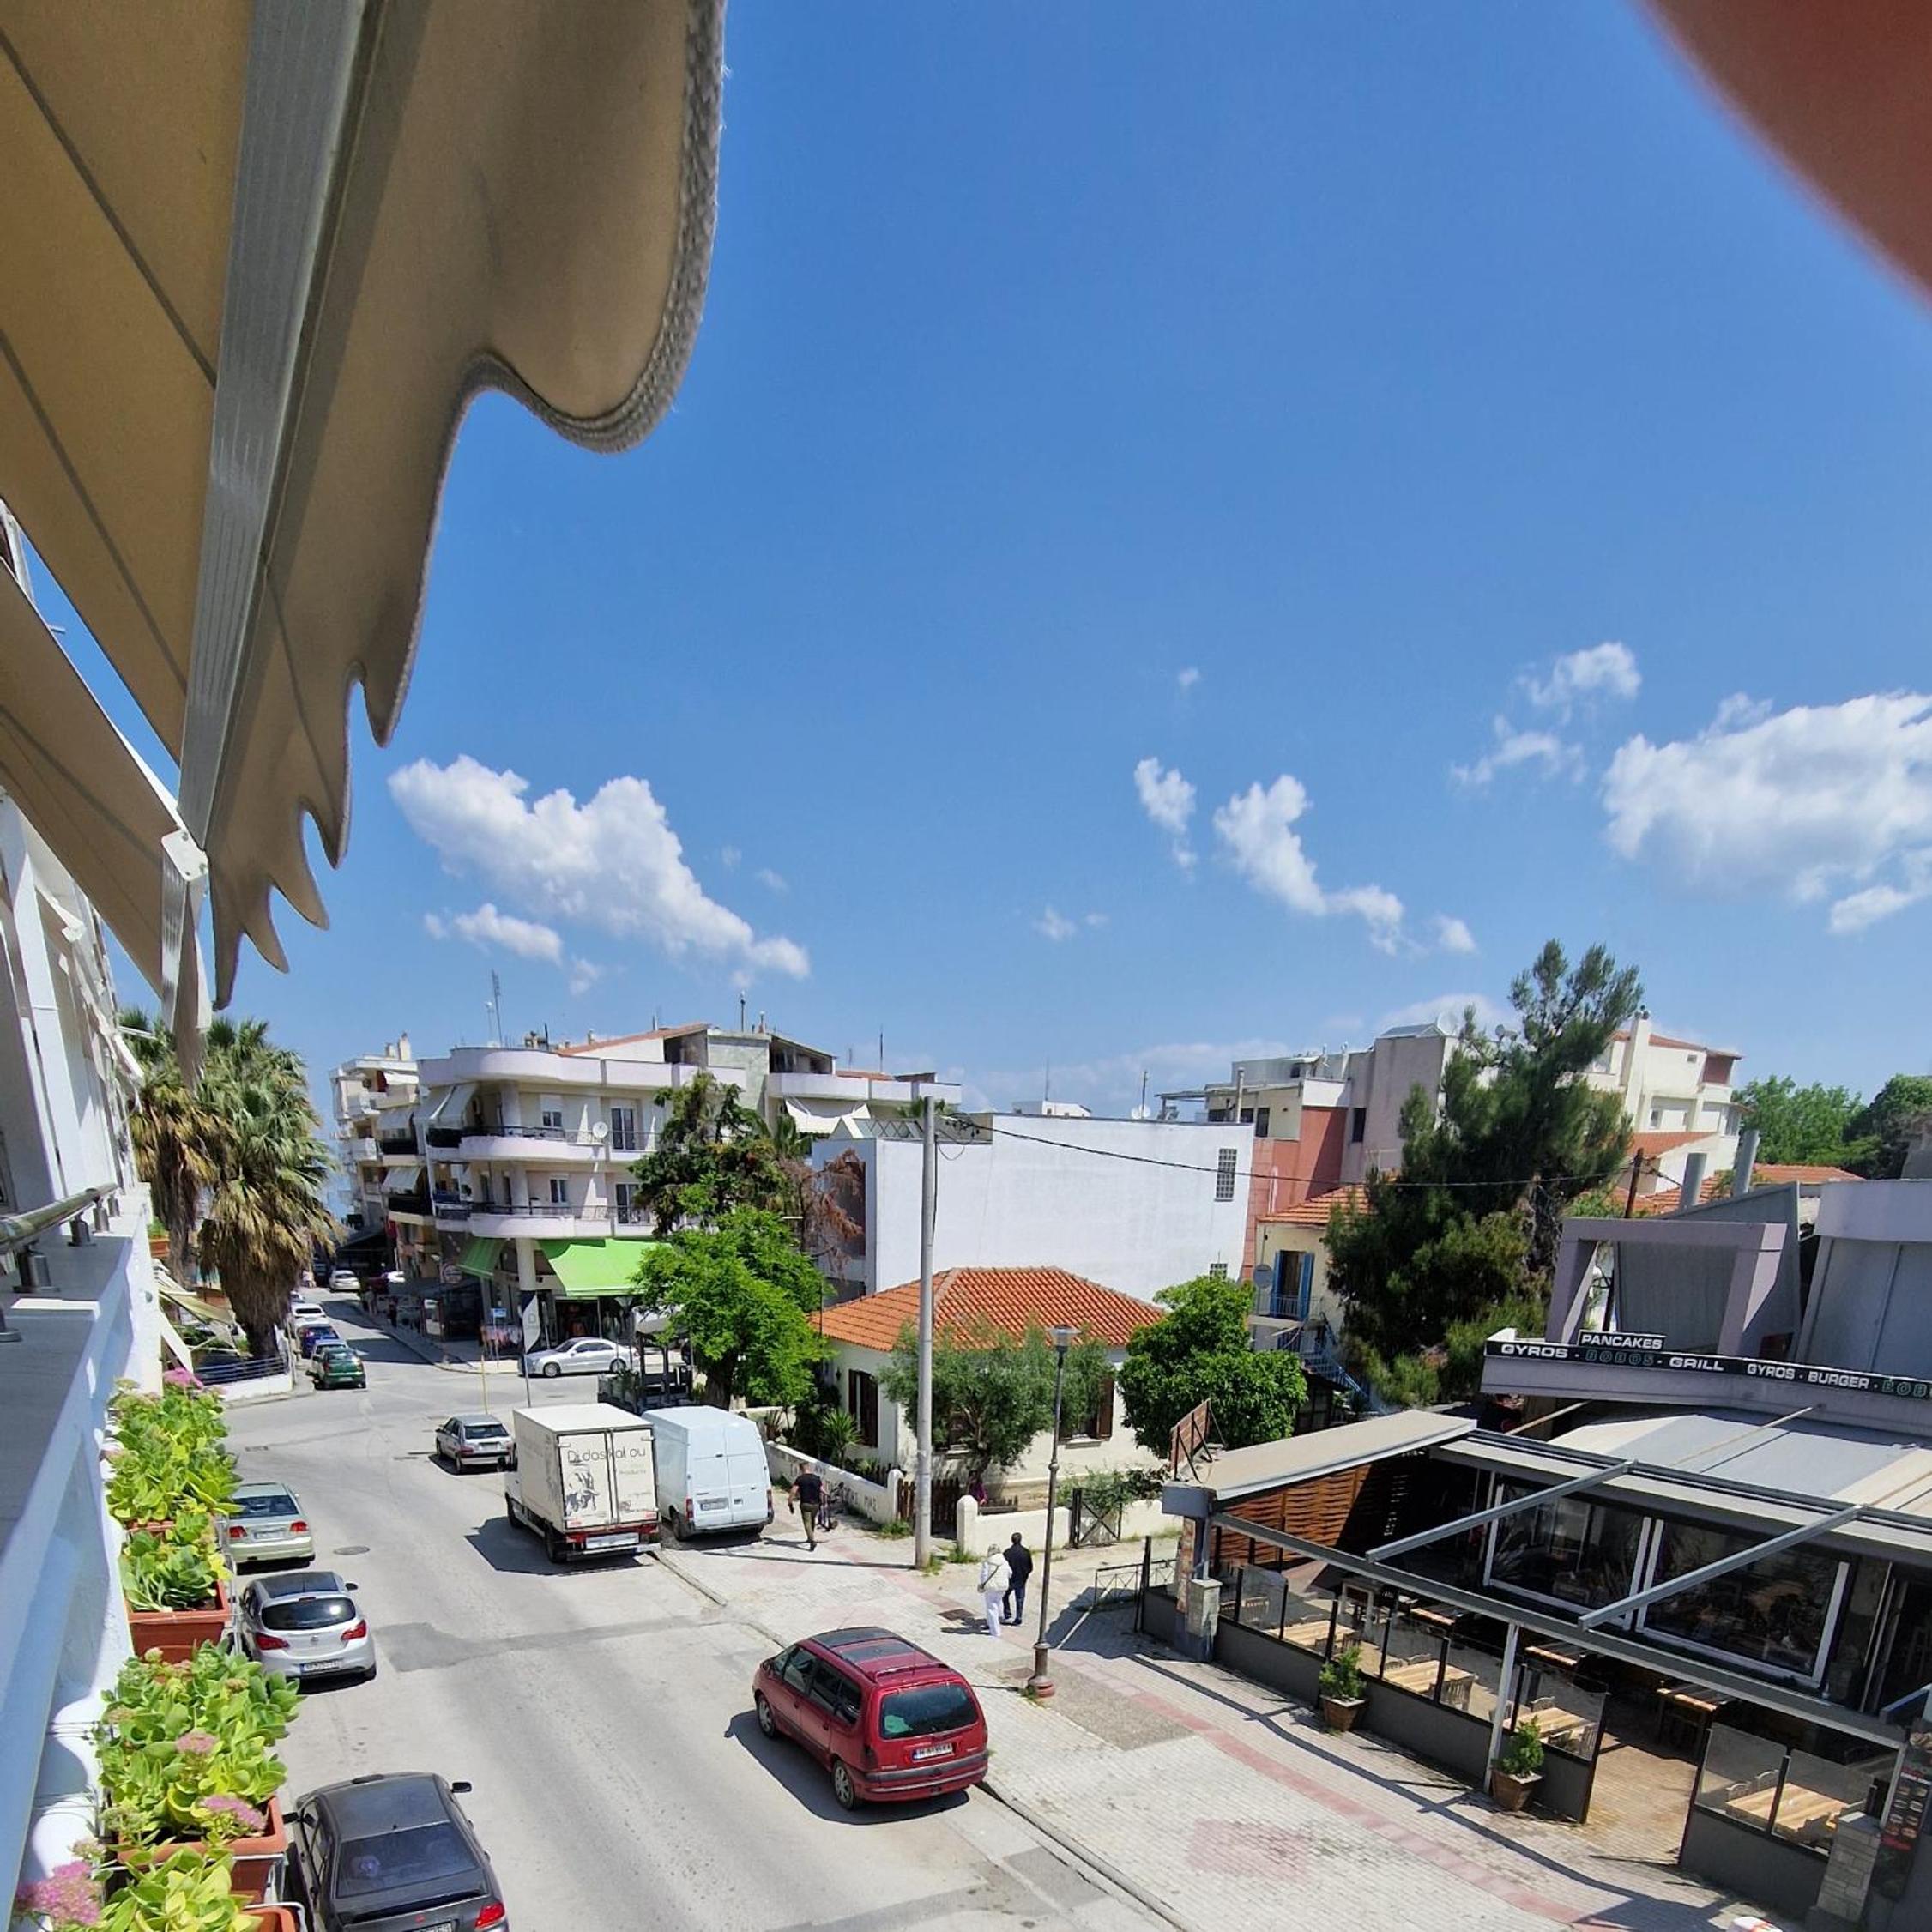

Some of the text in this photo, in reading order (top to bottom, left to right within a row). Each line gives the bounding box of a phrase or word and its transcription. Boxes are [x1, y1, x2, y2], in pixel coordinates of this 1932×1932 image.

[1581, 1334, 1663, 1350] PANCAKES
[1501, 1343, 1569, 1359] GYROS
[1669, 1356, 1724, 1372] GRILL
[1747, 1362, 1932, 1399] GYROS BURGER BOB
